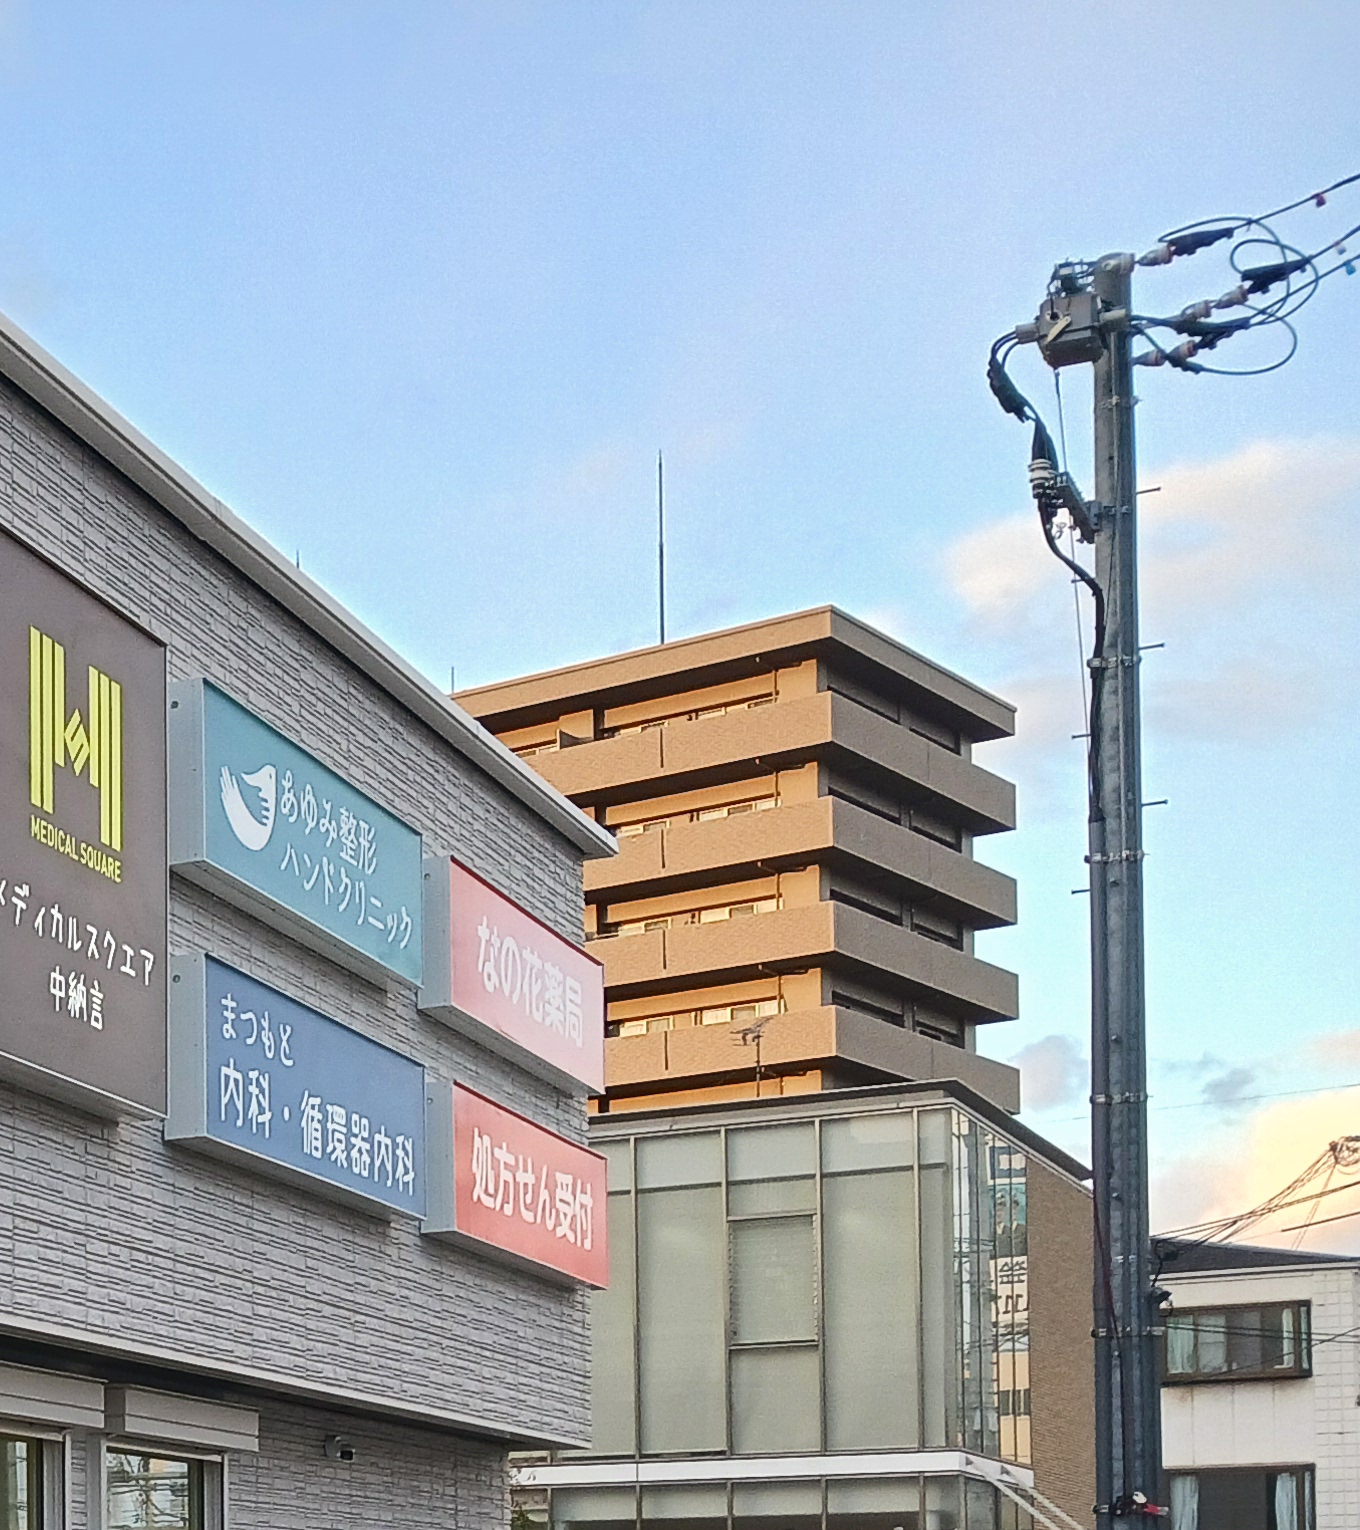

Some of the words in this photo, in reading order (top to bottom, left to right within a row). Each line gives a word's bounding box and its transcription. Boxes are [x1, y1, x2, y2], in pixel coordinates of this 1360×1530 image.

[30, 814, 79, 860] MEDICAL
[80, 842, 122, 883] SQUARE
[280, 770, 377, 874] あゆみ整形
[280, 843, 412, 949] ハンドクリニック
[49, 965, 104, 1030] 中納言
[221, 993, 294, 1067] まつもと
[477, 917, 583, 1047] なの花薬局
[220, 1059, 415, 1195] 内科・循環器内科
[471, 1128, 594, 1250] 処方せん受付
